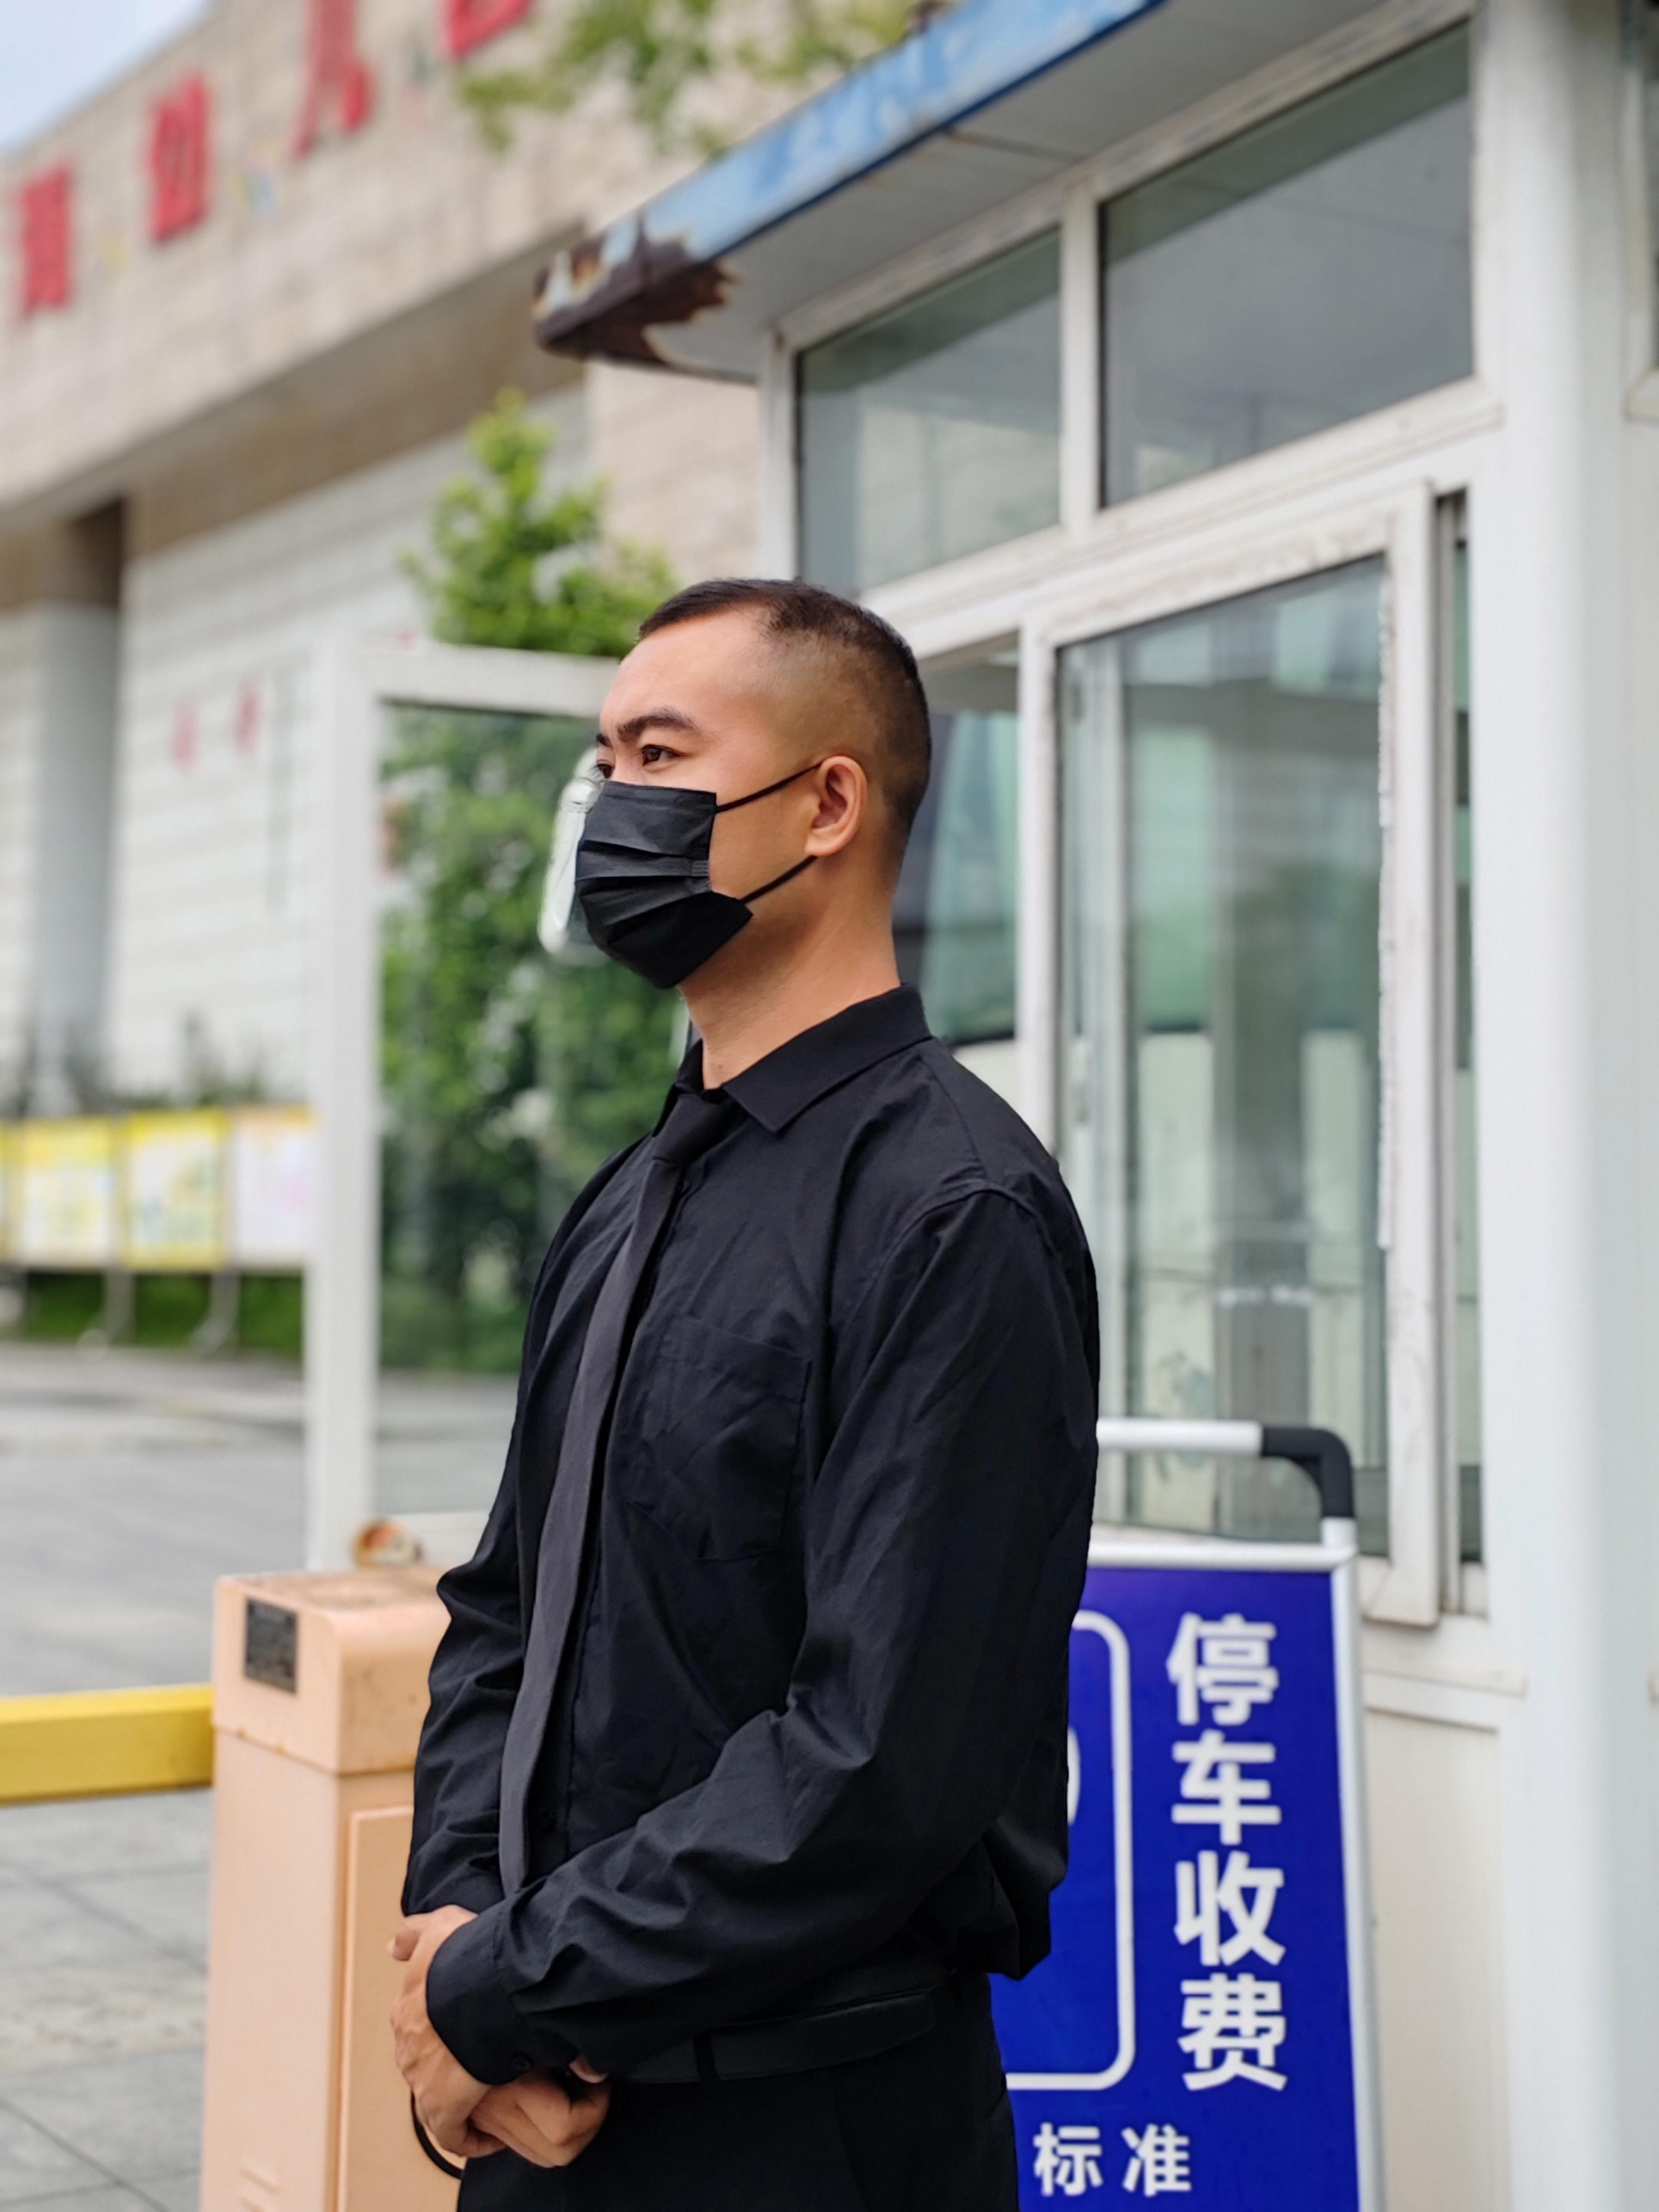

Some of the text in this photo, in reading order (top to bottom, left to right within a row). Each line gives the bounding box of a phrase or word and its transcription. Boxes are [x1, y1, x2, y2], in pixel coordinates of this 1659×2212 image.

[1166, 1613, 1287, 2091] 停车收费
[1033, 2122, 1192, 2197] 标准
